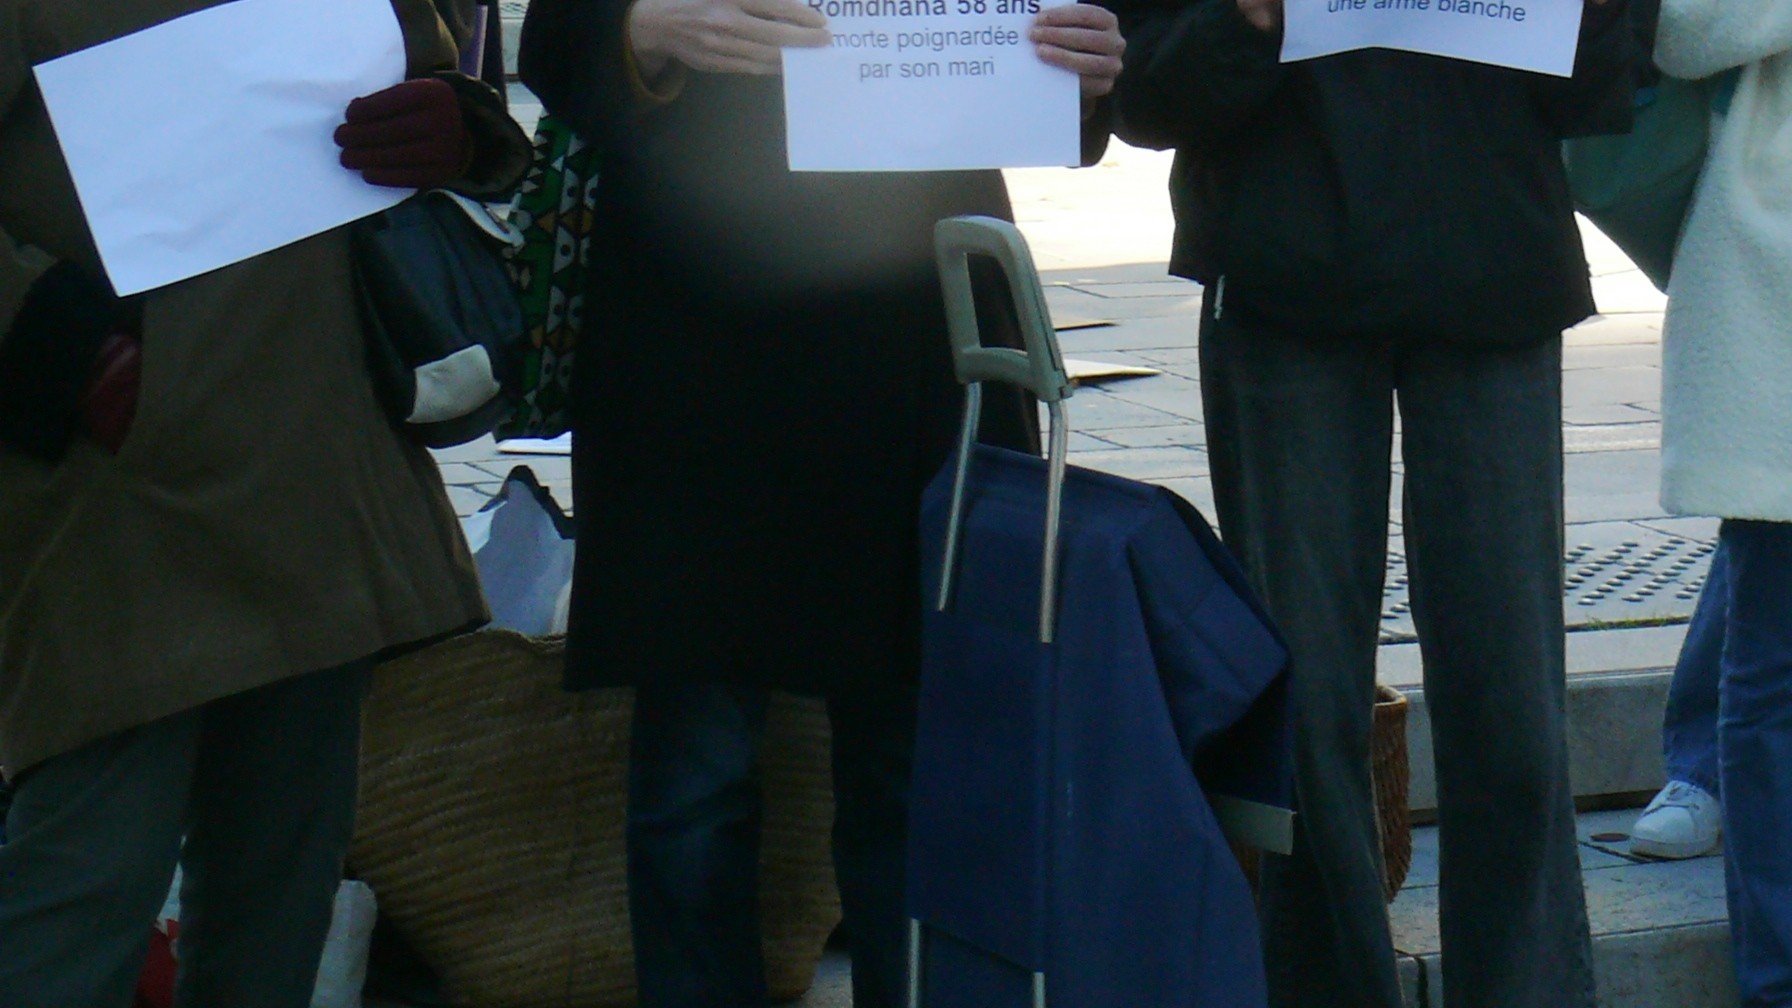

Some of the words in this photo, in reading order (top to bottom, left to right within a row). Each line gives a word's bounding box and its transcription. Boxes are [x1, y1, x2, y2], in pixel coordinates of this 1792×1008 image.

[832, 30, 888, 48] morte
[898, 26, 1019, 52] poignardée
[860, 64, 892, 82] par
[900, 63, 940, 78] son
[949, 56, 994, 77] mari
